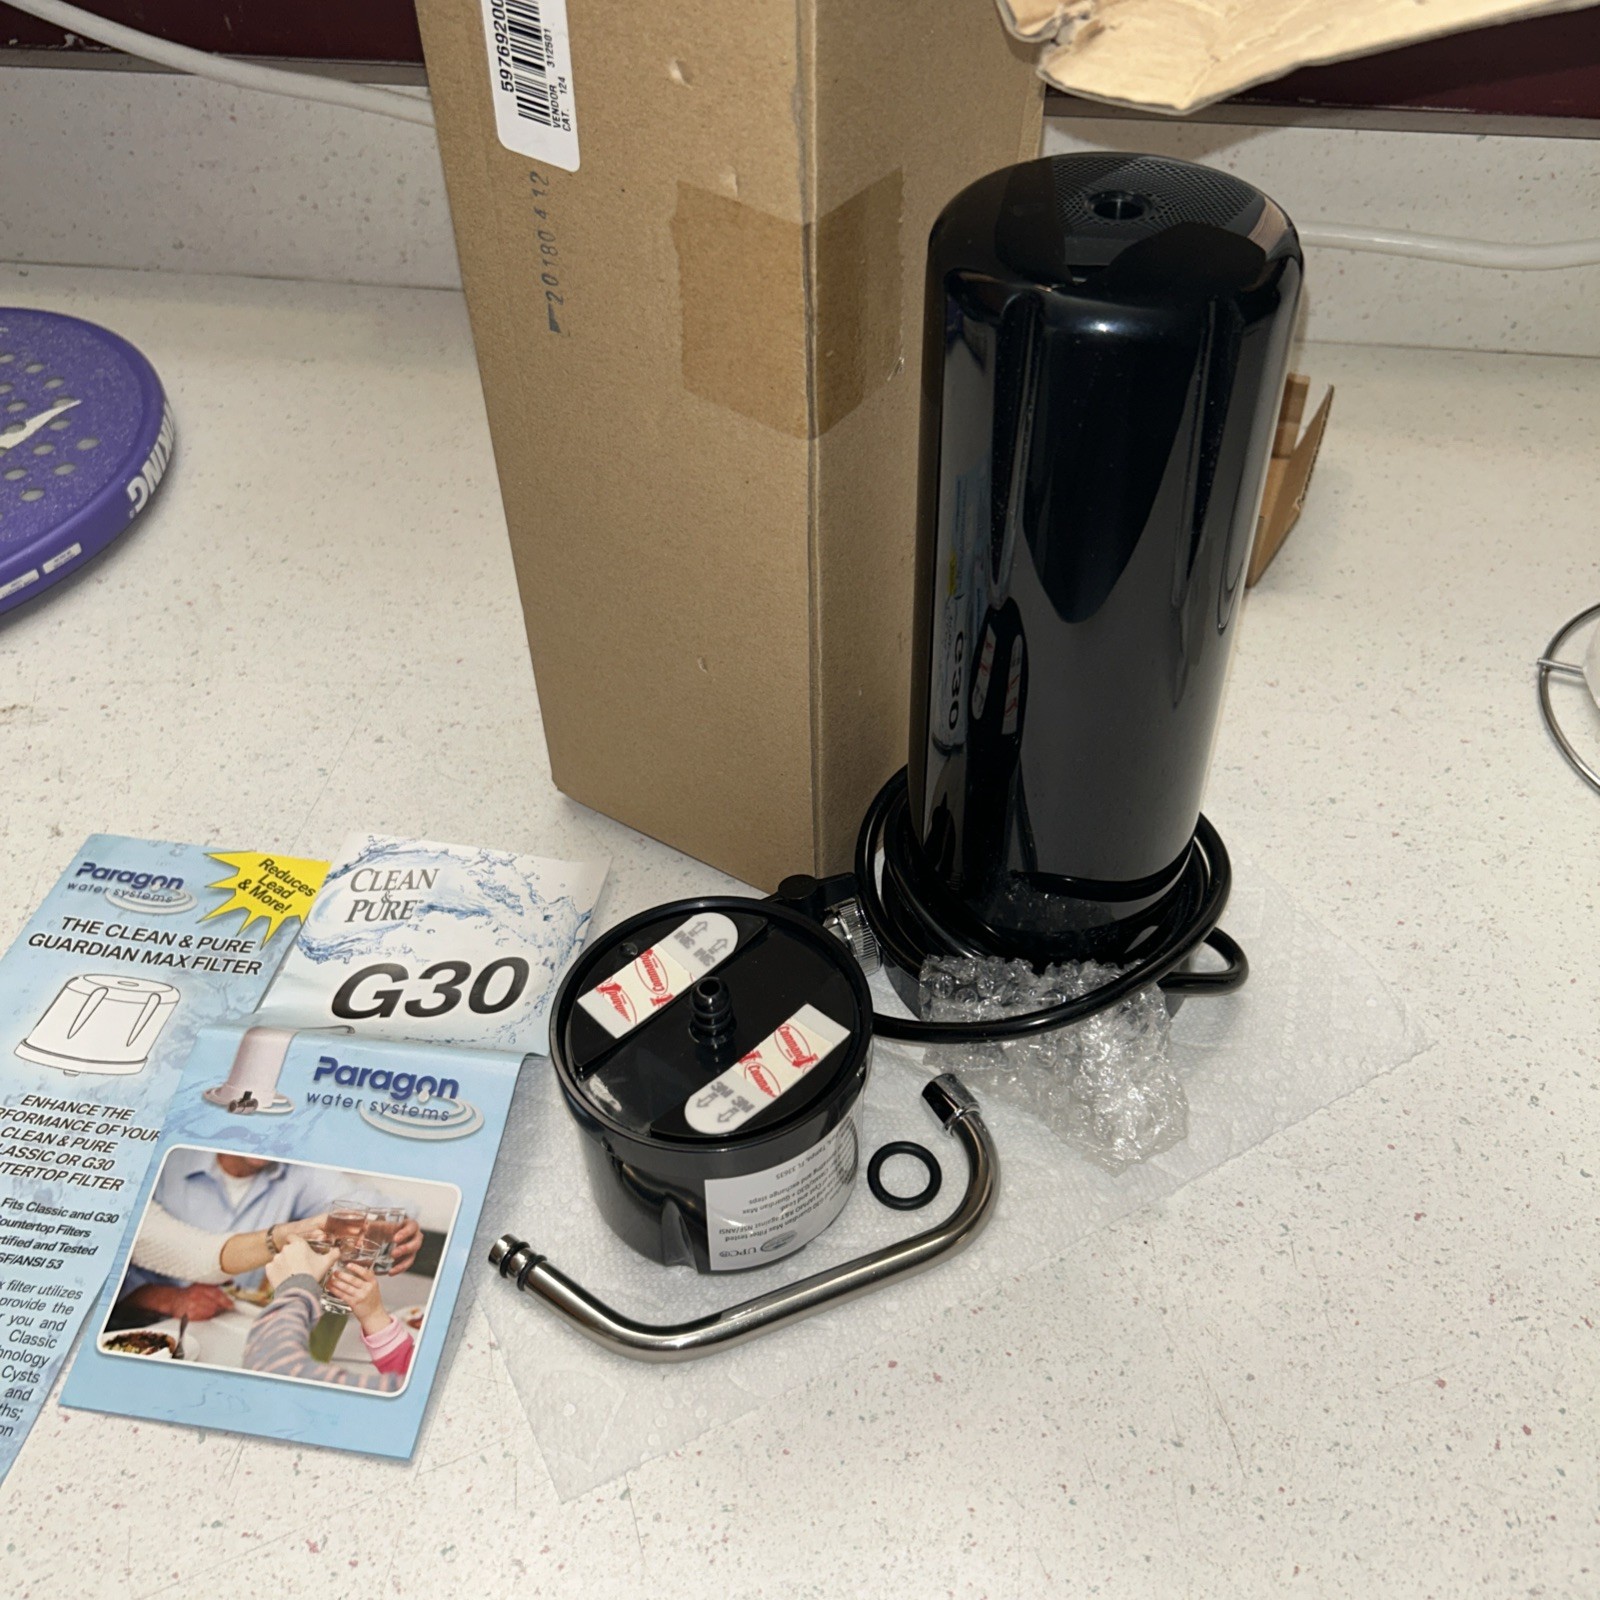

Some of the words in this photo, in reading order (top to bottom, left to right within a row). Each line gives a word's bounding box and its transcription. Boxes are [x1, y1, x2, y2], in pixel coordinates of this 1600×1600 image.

[558, 76, 567, 94] 124
[549, 84, 561, 128] VENDOR
[561, 109, 571, 132] CAT.
[76, 862, 184, 890] Paragon
[258, 858, 316, 897] Reduces
[258, 874, 296, 899] Lead
[350, 868, 440, 892] CLEAN
[67, 882, 111, 894] water
[113, 888, 173, 903] systems
[238, 879, 252, 891] &
[249, 885, 292, 914] More!
[381, 890, 393, 904] &
[62, 916, 103, 936] THE
[105, 922, 177, 947] CLEAN
[179, 936, 194, 949] &
[197, 937, 256, 954] PURE
[28, 933, 141, 962] GUARDIAN
[140, 951, 194, 970] MAX
[191, 957, 263, 976] FILTER
[330, 957, 530, 1019] G30
[313, 1056, 459, 1101] Paragon
[21, 1094, 102, 1116] ENHANCE
[100, 1106, 135, 1121] THE
[307, 1092, 363, 1109] water
[369, 1101, 450, 1122] systems
[1, 1126, 58, 1145] CLEAN
[57, 1136, 69, 1147] &
[71, 1137, 118, 1153] PURE
[95, 1123, 121, 1136] OF
[56, 1153, 82, 1167] OR
[82, 1157, 115, 1171] G30
[67, 1172, 125, 1191] FILTER
[1, 1197, 25, 1211] Fits
[26, 1201, 69, 1218] Classic
[69, 1209, 94, 1222] and
[94, 1214, 120, 1224] G30
[0, 1215, 55, 1235] ountertop
[55, 1224, 92, 1238] Filters
[750, 1229, 767, 1238] Filter
[769, 1224, 783, 1232] Max
[725, 1233, 748, 1242] tested
[33, 1241, 58, 1251] and
[59, 1242, 98, 1256] Tested
[46, 1259, 64, 1269] 53
[6, 1279, 37, 1293] filter
[37, 1285, 83, 1300] utilizes
[52, 1302, 75, 1315] the
[6, 1314, 35, 1327] you
[39, 1319, 68, 1332] and
[9, 1329, 58, 1349] Classic
[1, 1365, 40, 1384] Cysts
[4, 1387, 34, 1401] and
